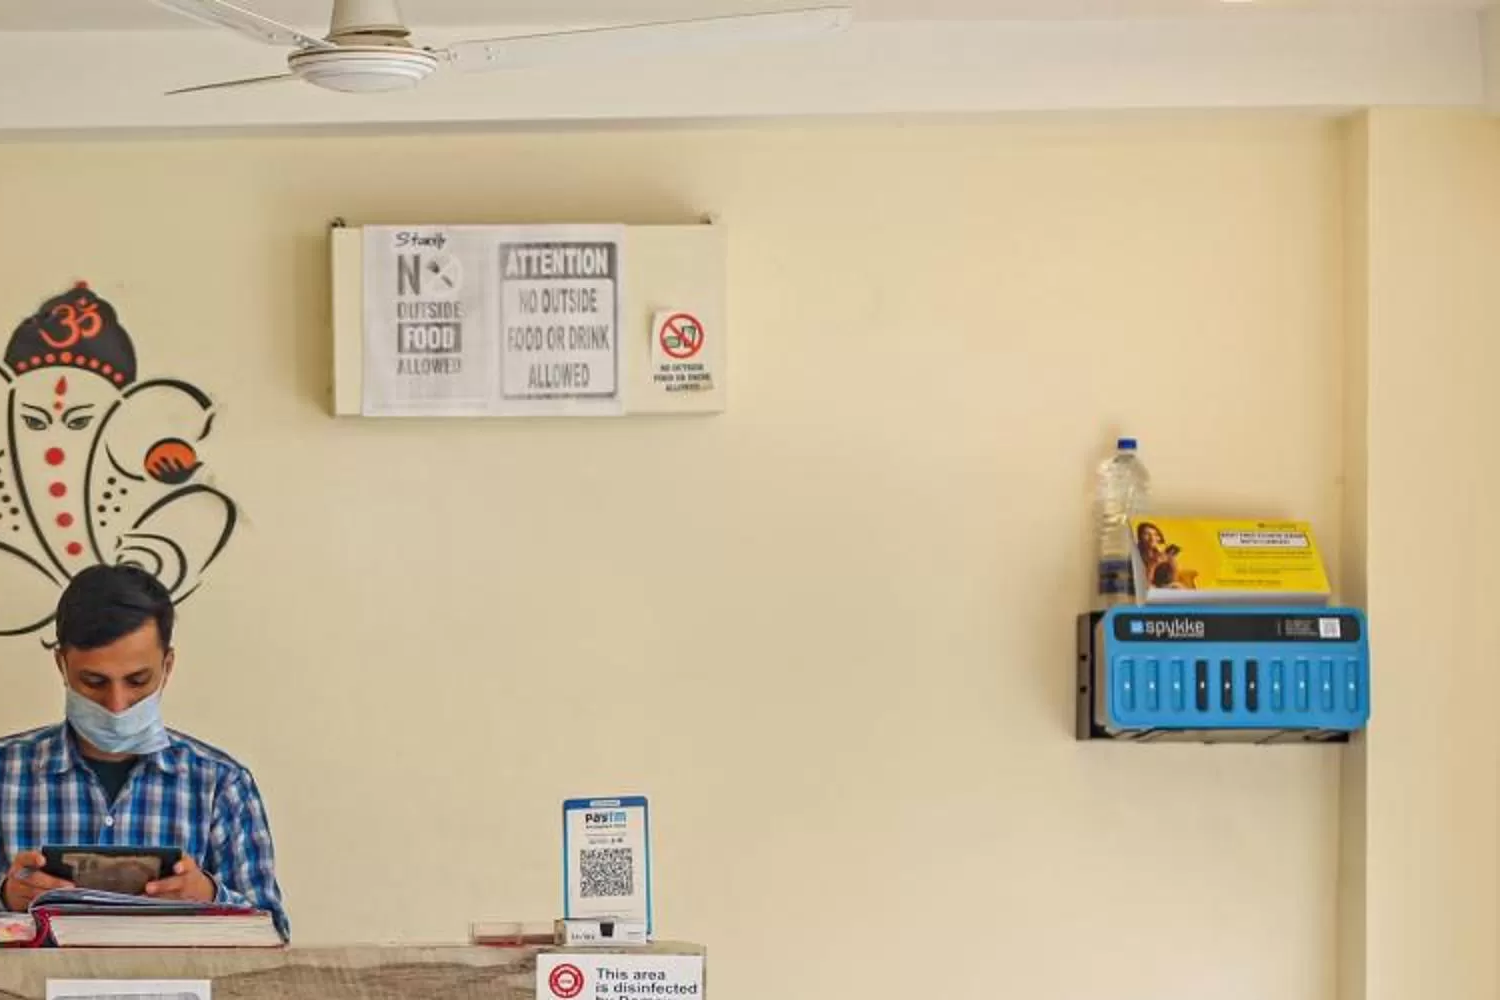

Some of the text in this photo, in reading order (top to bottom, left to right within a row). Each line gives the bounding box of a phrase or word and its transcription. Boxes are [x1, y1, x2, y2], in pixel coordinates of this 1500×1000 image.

[505, 248, 609, 276] ATTENTION
[397, 302, 461, 318] OUTSIDE
[518, 288, 598, 313] NO OUTSIDE
[406, 327, 454, 349] FOOD
[508, 324, 610, 352] FOOD OR DRINK
[397, 358, 461, 375] ALLOWED
[528, 363, 591, 388] ALLOWED
[1145, 619, 1204, 637] spykke
[596, 968, 666, 981] This area
[595, 983, 697, 995] is disinfected
